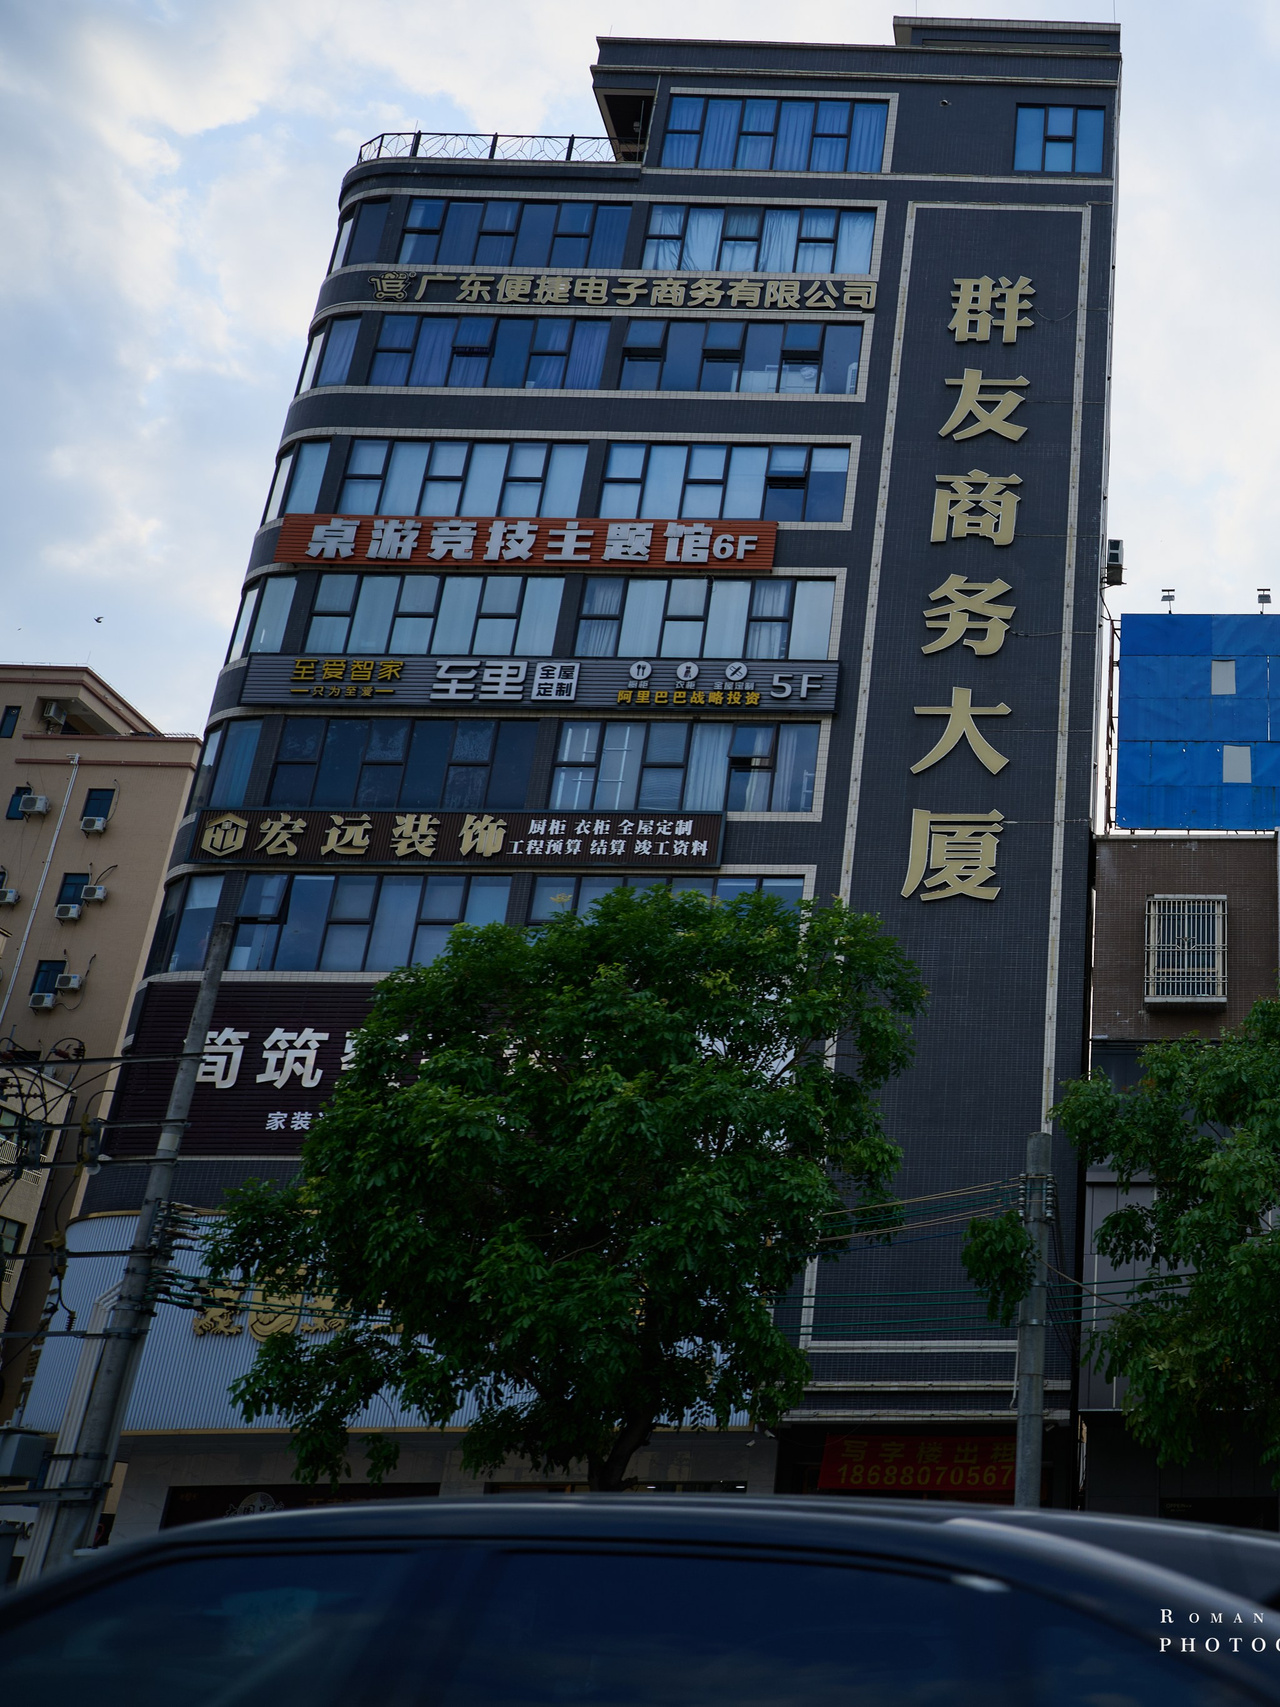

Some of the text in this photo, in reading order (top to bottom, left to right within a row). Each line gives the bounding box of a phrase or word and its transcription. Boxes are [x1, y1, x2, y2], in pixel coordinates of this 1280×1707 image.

[414, 273, 877, 309] 广东便捷电子商务有限公司
[901, 275, 1035, 901] 群友商务大厦
[290, 659, 404, 680] 至爱智家
[539, 665, 575, 680] 全屋
[536, 682, 573, 697] 定制
[770, 673, 823, 699] 5F
[617, 690, 761, 705] 阿里巴巴战略投资
[254, 813, 507, 857] 宏远装饰
[574, 819, 611, 836] 衣柜
[617, 819, 693, 836] 全屋定制
[506, 839, 709, 857] 工程预算 结算 竣工资料
[840, 1439, 1017, 1465] 写字楼出租
[836, 1464, 1015, 1487] 18688070567
